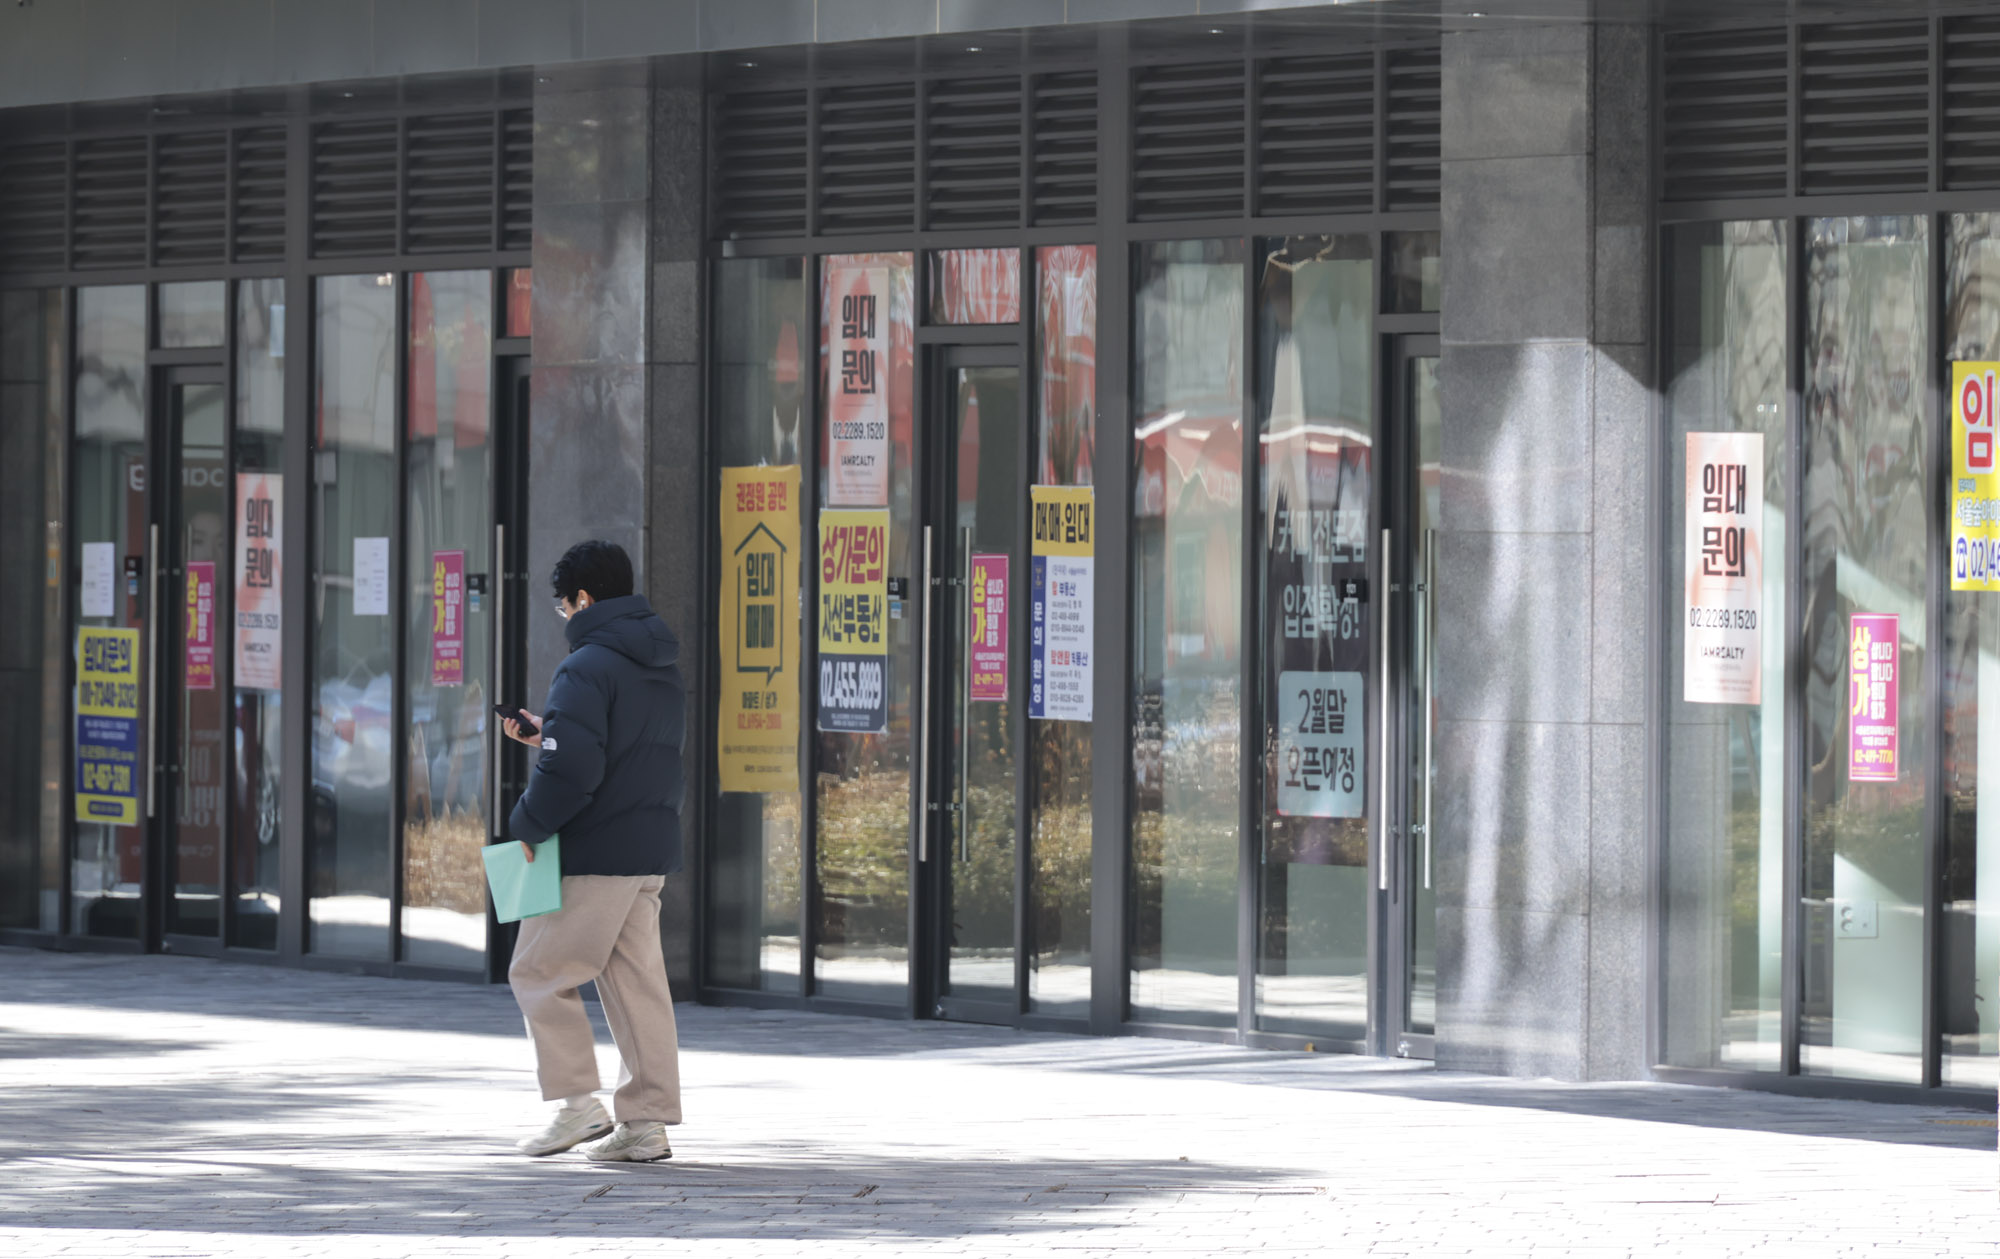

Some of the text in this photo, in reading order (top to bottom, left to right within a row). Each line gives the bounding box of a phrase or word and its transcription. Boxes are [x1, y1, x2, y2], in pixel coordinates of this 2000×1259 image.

[842, 295, 875, 339] 임대
[841, 349, 875, 394] 문의
[833, 422, 885, 441] 02.2289.1520
[1962, 370, 2000, 467] 임
[736, 481, 765, 512] 권정원
[1703, 463, 1746, 514] 임대
[246, 498, 274, 539] 임대
[245, 548, 273, 588] 문의
[746, 552, 775, 597] 임대
[822, 525, 884, 584] 상가문의
[1701, 526, 1746, 577] 문의
[746, 603, 774, 649] 매매
[822, 594, 882, 644] 자산부동산
[973, 566, 988, 644] 상가
[1690, 608, 1757, 630] 02.2289.1520
[1852, 626, 1871, 717] 상가
[1298, 688, 1347, 735] 2월말
[1284, 747, 1355, 793] 오픈예정
